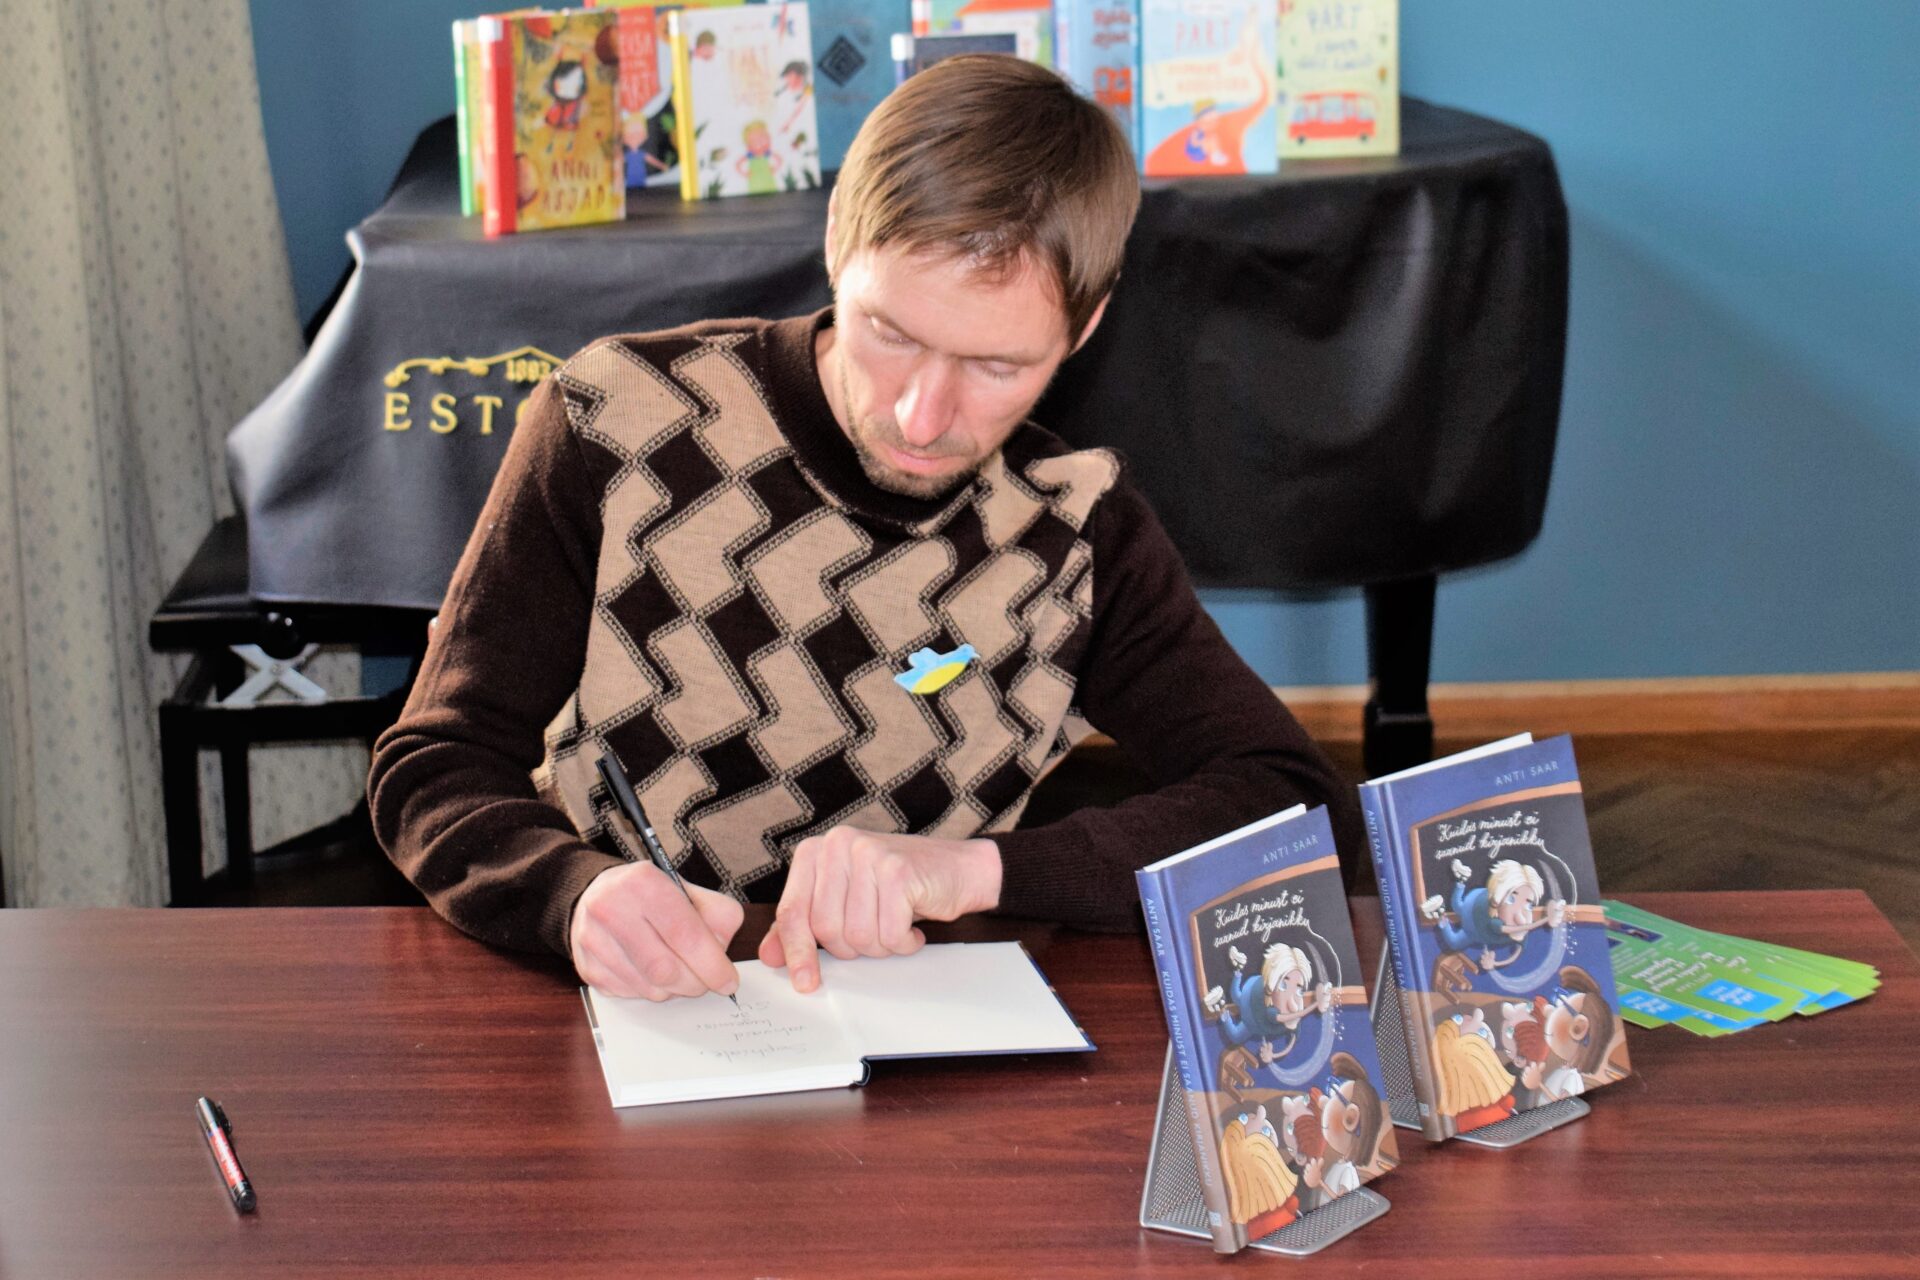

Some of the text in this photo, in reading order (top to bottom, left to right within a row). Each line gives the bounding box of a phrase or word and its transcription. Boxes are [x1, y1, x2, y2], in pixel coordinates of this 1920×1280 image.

[384, 392, 531, 435] EST
[1495, 760, 1560, 787] ANTI SAAR
[1367, 809, 1379, 836] ANTI
[1438, 819, 1477, 842] Kuidas
[1479, 811, 1522, 831] minust
[1263, 833, 1319, 865] ANTI SAAR
[1372, 837, 1384, 865] SAAR
[1215, 902, 1249, 929] Kuidas
[1251, 890, 1289, 912] minust
[1380, 877, 1394, 915] KUIDAS
[1388, 918, 1401, 957] MINUST
[1146, 897, 1158, 927] ANTI
[1152, 928, 1165, 957] SAAR
[1162, 970, 1177, 1012] KUIDAS
[1170, 1014, 1186, 1056] MINUST
